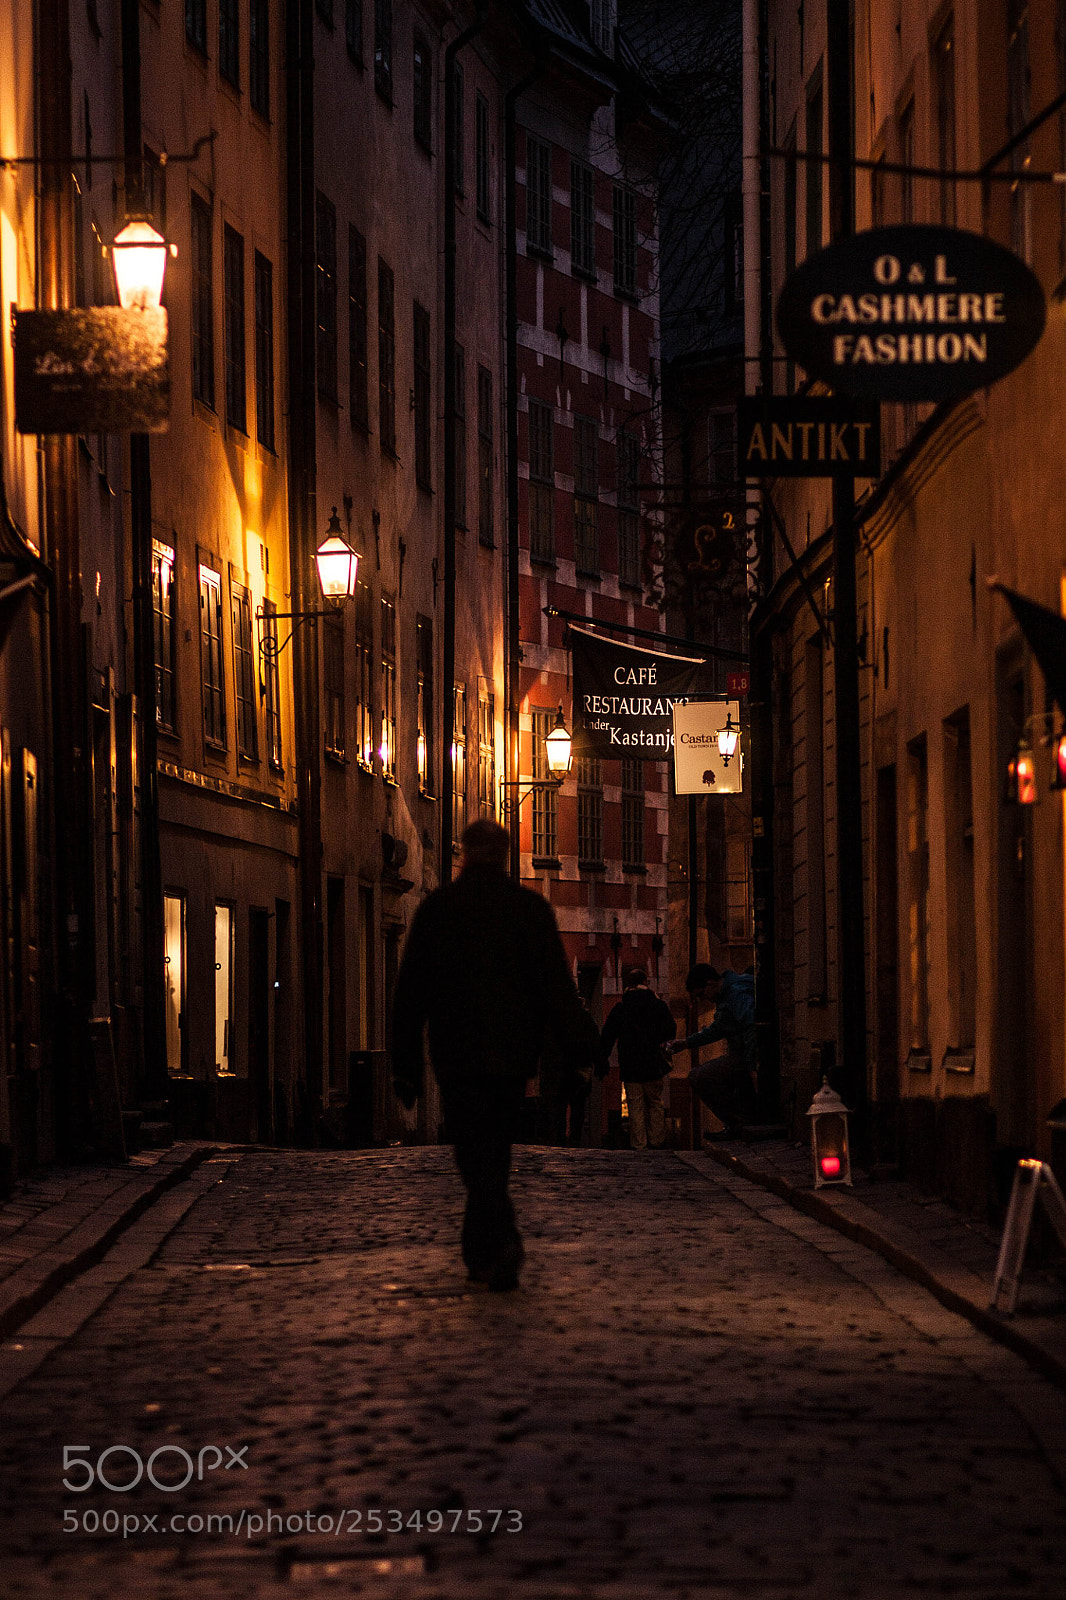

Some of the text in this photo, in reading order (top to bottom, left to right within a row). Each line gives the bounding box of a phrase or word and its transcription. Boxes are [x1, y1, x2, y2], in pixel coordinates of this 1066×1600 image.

[873, 254, 901, 285] O
[935, 254, 958, 285] L
[810, 292, 1007, 325] CASHMERE
[832, 332, 988, 366] FASHION
[746, 421, 872, 461] ANTIKT
[613, 662, 658, 686] CAFÉ
